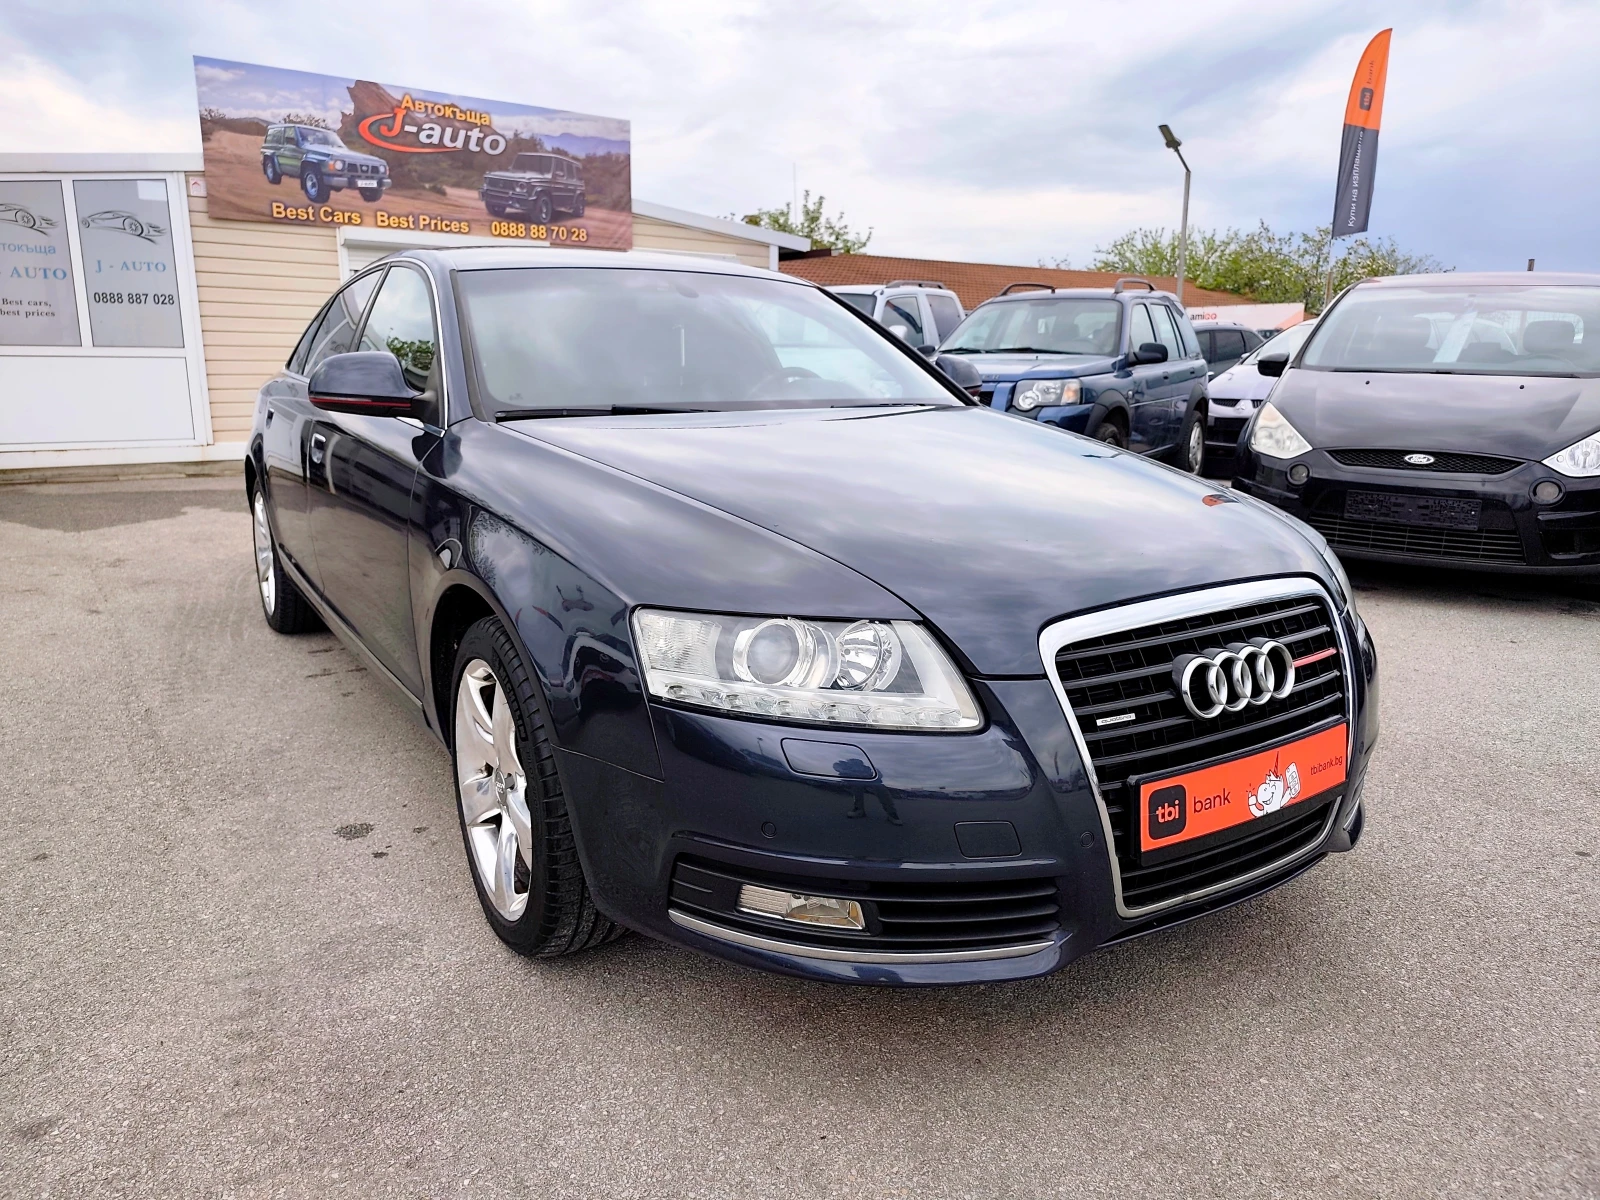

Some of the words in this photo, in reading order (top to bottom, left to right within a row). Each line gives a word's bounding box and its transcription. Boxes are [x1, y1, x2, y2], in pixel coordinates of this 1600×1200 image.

[401, 93, 491, 127] Автокъща
[379, 107, 507, 156] J-auto
[1351, 189, 1358, 201] на
[271, 202, 315, 221] Best
[319, 206, 361, 225] Cars
[376, 211, 415, 229] Best
[419, 214, 470, 233] Prices
[1347, 203, 1356, 227] Купи
[491, 221, 526, 238] 0888
[530, 225, 547, 239] 88
[551, 226, 567, 241] 70
[571, 227, 588, 242] 28
[0, 243, 56, 256] токъща
[10, 266, 67, 280] AUTO
[120, 261, 166, 273] AUTO
[2, 298, 23, 306] Best
[27, 300, 52, 308] cars,
[93, 292, 124, 304] 0888
[127, 293, 149, 305] 887
[153, 293, 175, 305] 028
[0, 308, 20, 317] best
[25, 308, 56, 319] prices
[1310, 755, 1343, 776] tbibank.bg
[1155, 799, 1180, 823] tbi
[1193, 787, 1231, 814] bank
